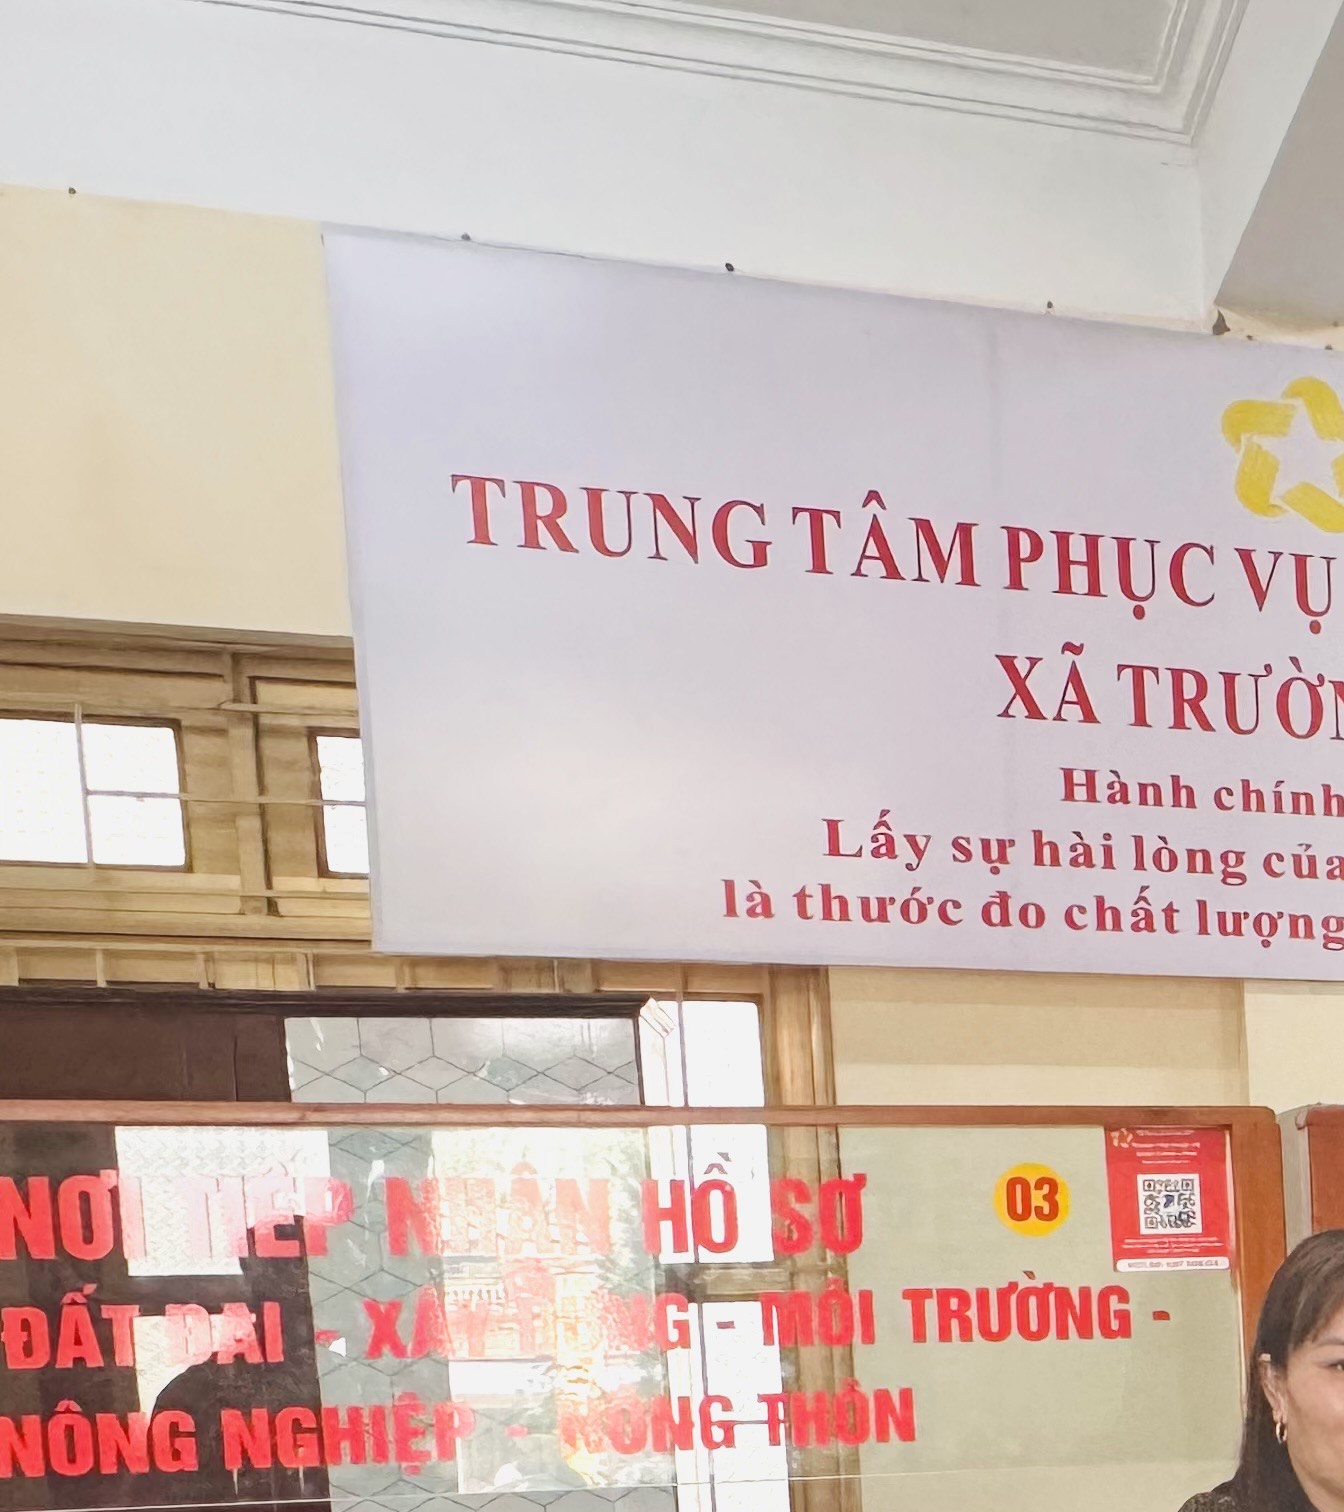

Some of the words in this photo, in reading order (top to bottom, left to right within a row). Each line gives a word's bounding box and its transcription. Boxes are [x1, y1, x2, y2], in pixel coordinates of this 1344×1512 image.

[451, 473, 773, 570] TRUNG
[791, 489, 980, 589] TÂM
[1001, 524, 1215, 621] PHỤC
[1233, 546, 1336, 635] VỤ
[995, 640, 1100, 725] XÃ
[1059, 767, 1197, 810] Hành
[824, 808, 931, 873] Lấy
[951, 835, 1016, 876] sự
[1031, 828, 1116, 871] hài
[1132, 834, 1248, 888] lòng
[723, 879, 774, 921] là
[792, 882, 962, 927] thước
[979, 889, 1048, 930] đo
[1062, 886, 1179, 936] chất
[642, 1152, 738, 1256] HỒ
[771, 1173, 867, 1256] SƠ
[1005, 1175, 1060, 1223] 03
[2, 1283, 142, 1369] ĐẤT
[758, 1276, 875, 1349] MÔI
[901, 1270, 1133, 1344] TRƯỜNG
[0, 1400, 197, 1478] NÔNG
[222, 1391, 476, 1475] NGHIỆP
[757, 1377, 917, 1447] THÔN
